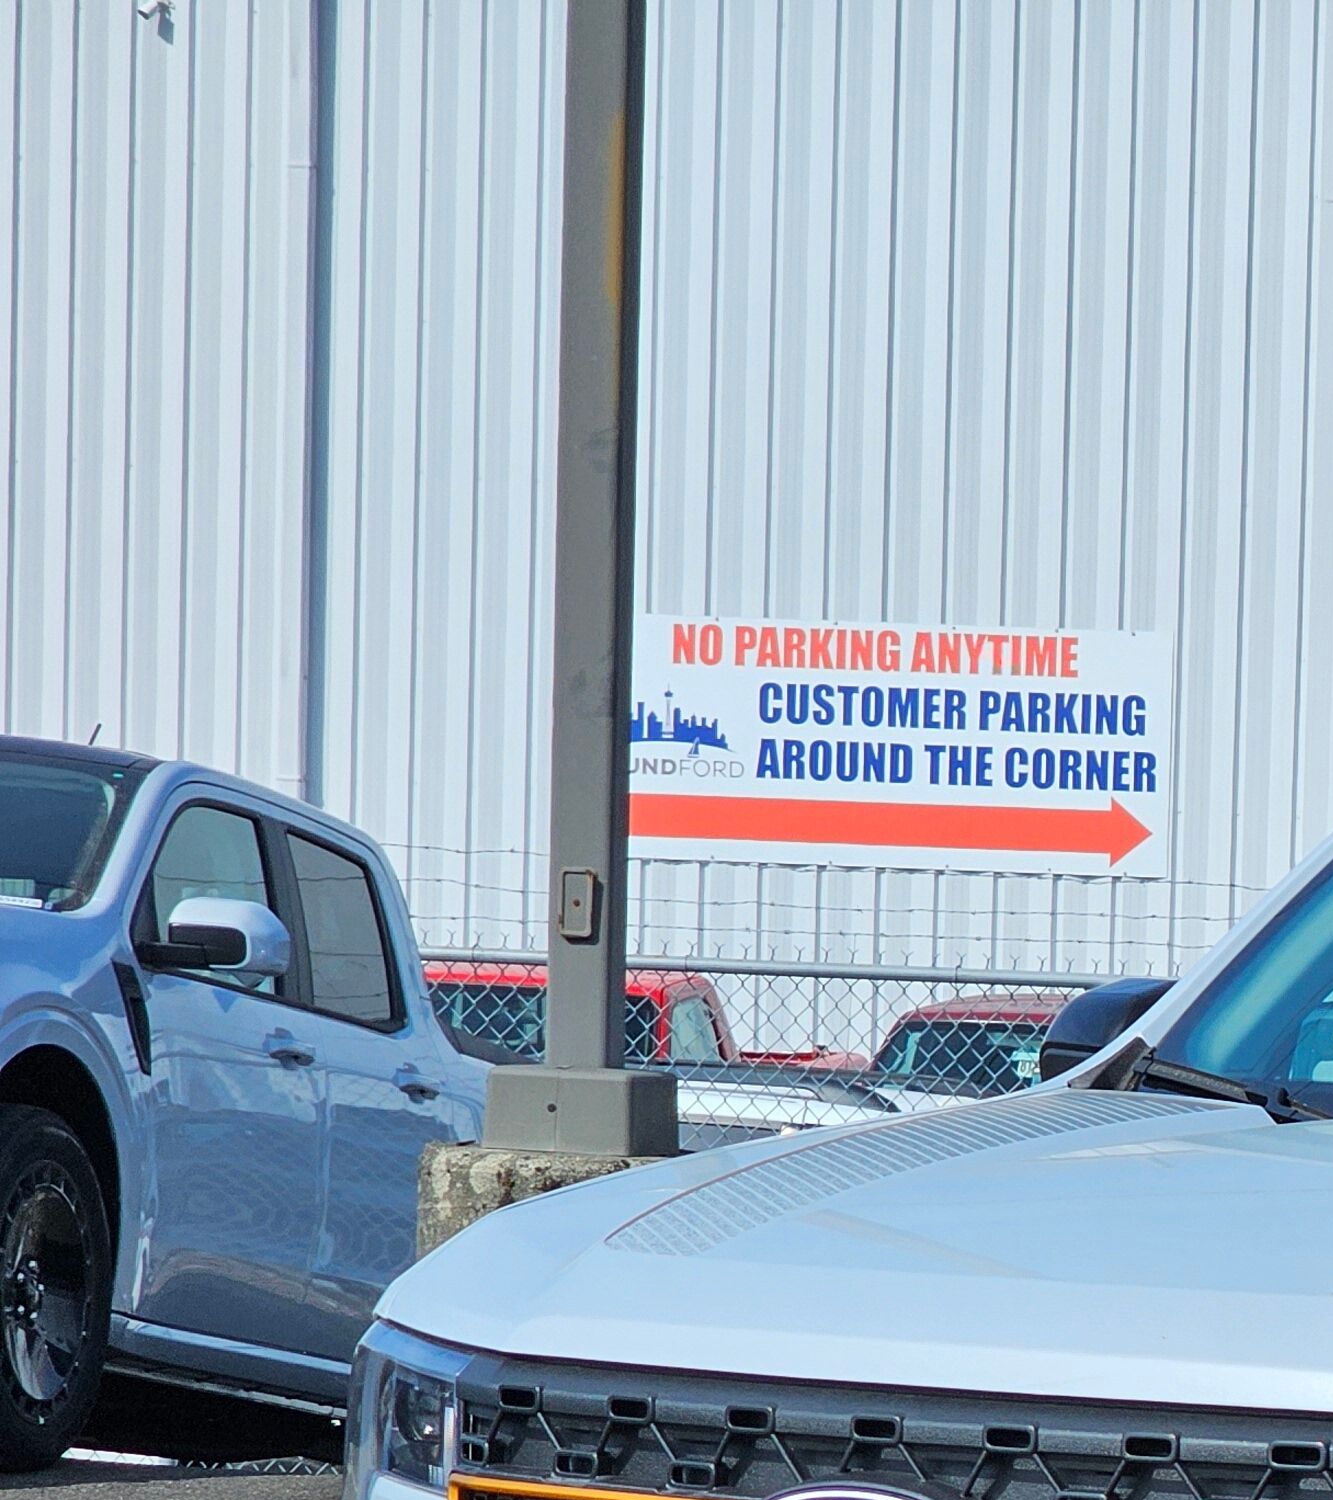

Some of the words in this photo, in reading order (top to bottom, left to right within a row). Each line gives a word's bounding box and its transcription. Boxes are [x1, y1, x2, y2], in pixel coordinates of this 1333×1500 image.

[672, 623, 723, 667] NO
[734, 625, 901, 673] PARKING
[911, 631, 1080, 679] ANYTIME
[758, 682, 967, 732] CUSTOMER
[978, 690, 1147, 737] PARKING
[629, 757, 745, 778] UNDFORD
[756, 738, 912, 785] AROUND
[923, 744, 994, 788] THE
[1004, 747, 1157, 793] CORNER
